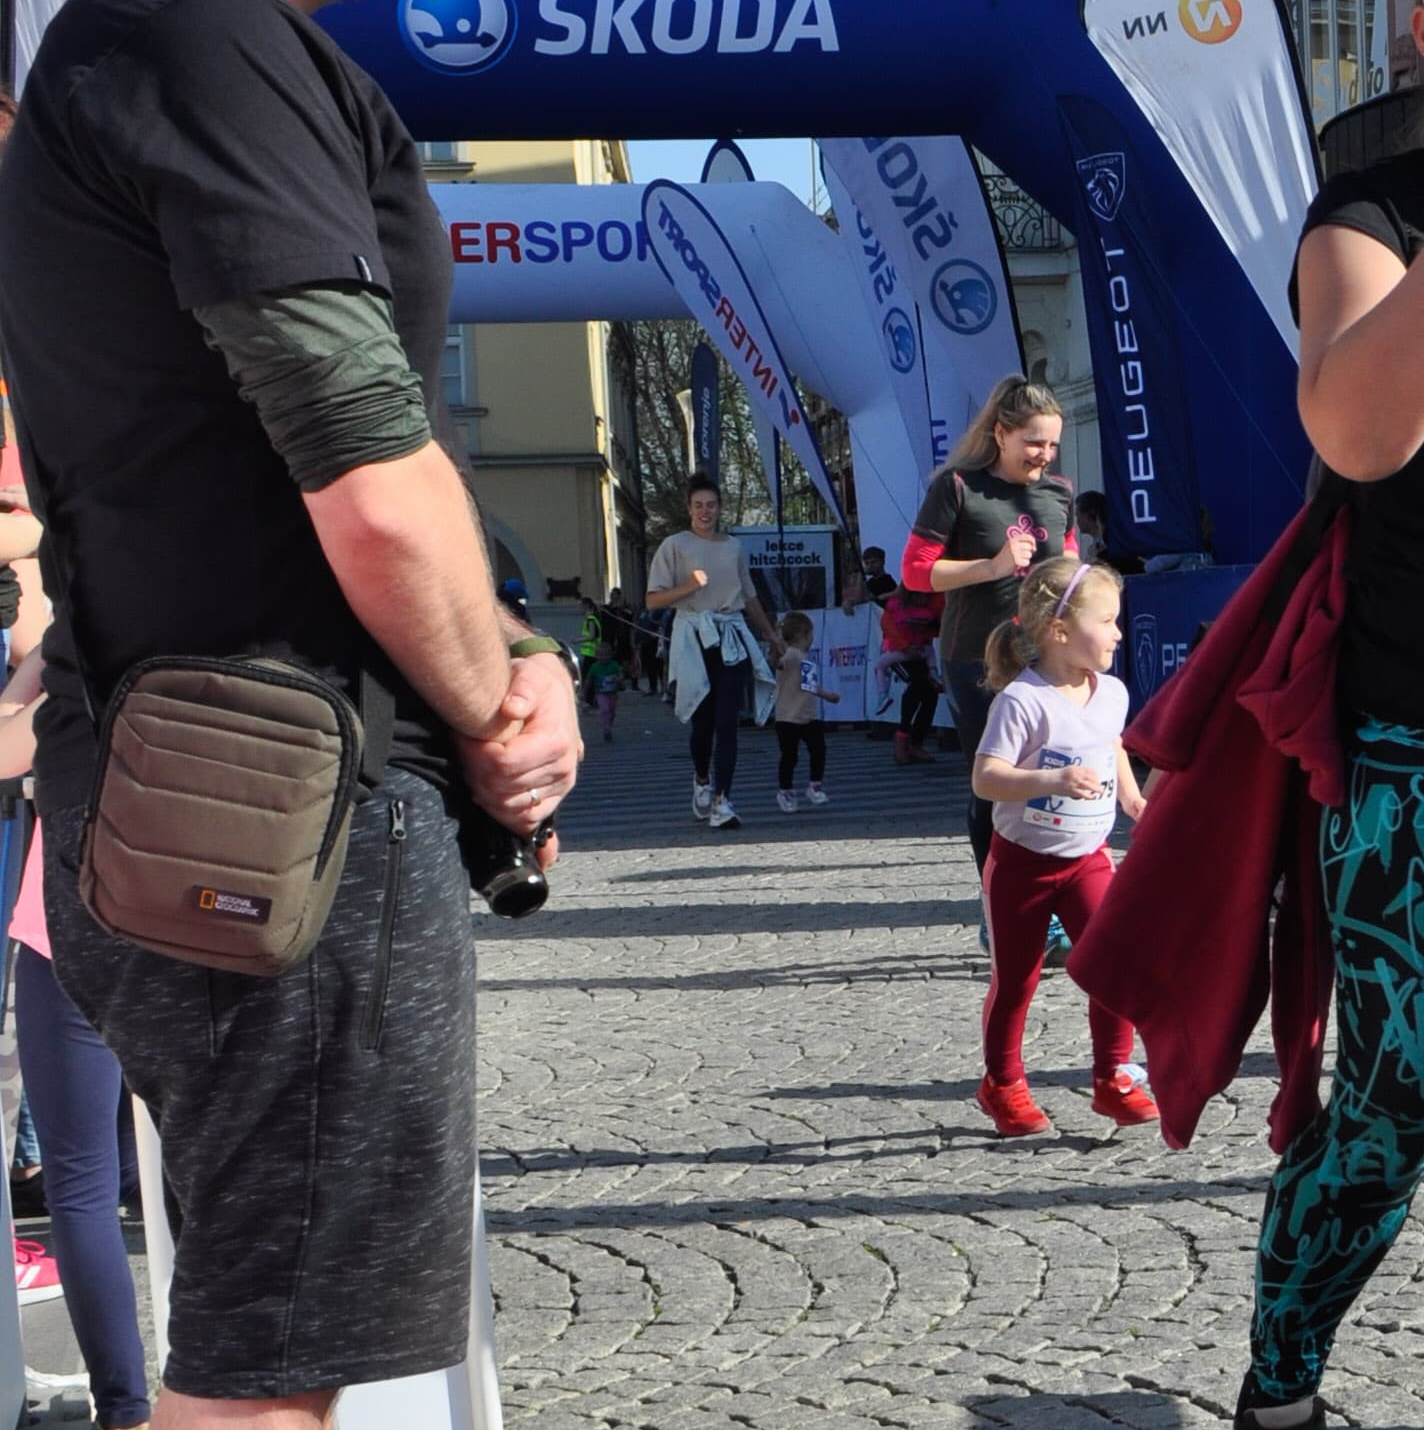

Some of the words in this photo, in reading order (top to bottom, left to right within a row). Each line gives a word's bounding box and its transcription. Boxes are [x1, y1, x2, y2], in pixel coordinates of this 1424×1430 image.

[1101, 236, 1158, 523] PEUGEOT
[765, 539, 804, 553] lekce
[750, 553, 821, 566] hitchcock
